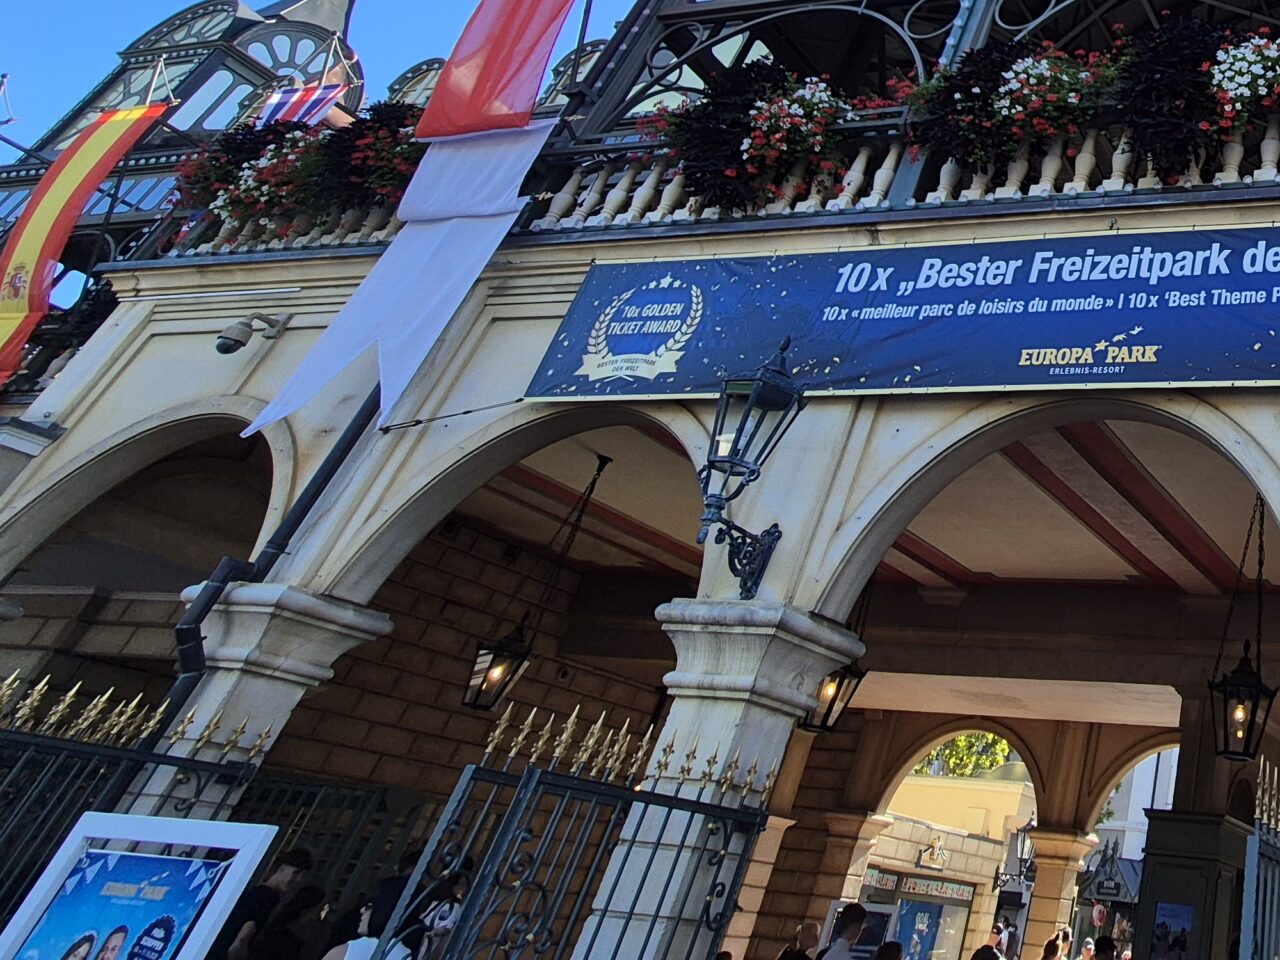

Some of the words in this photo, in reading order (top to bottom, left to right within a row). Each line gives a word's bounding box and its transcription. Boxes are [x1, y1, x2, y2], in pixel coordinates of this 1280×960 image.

[1028, 242, 1233, 286] Freizeitpark
[622, 304, 641, 318] 10x
[641, 302, 685, 317] GOLDEN
[918, 303, 954, 321] parc
[957, 299, 977, 316] de
[978, 297, 1026, 315] loisirs
[1027, 296, 1048, 313] du
[1212, 288, 1267, 306] Theme
[607, 321, 644, 336] TICKET
[641, 319, 682, 334] AWARD
[1018, 346, 1094, 366] EUROPA
[1105, 344, 1159, 364] PARK
[1049, 365, 1126, 375] ERLEBNIS-RESORT
